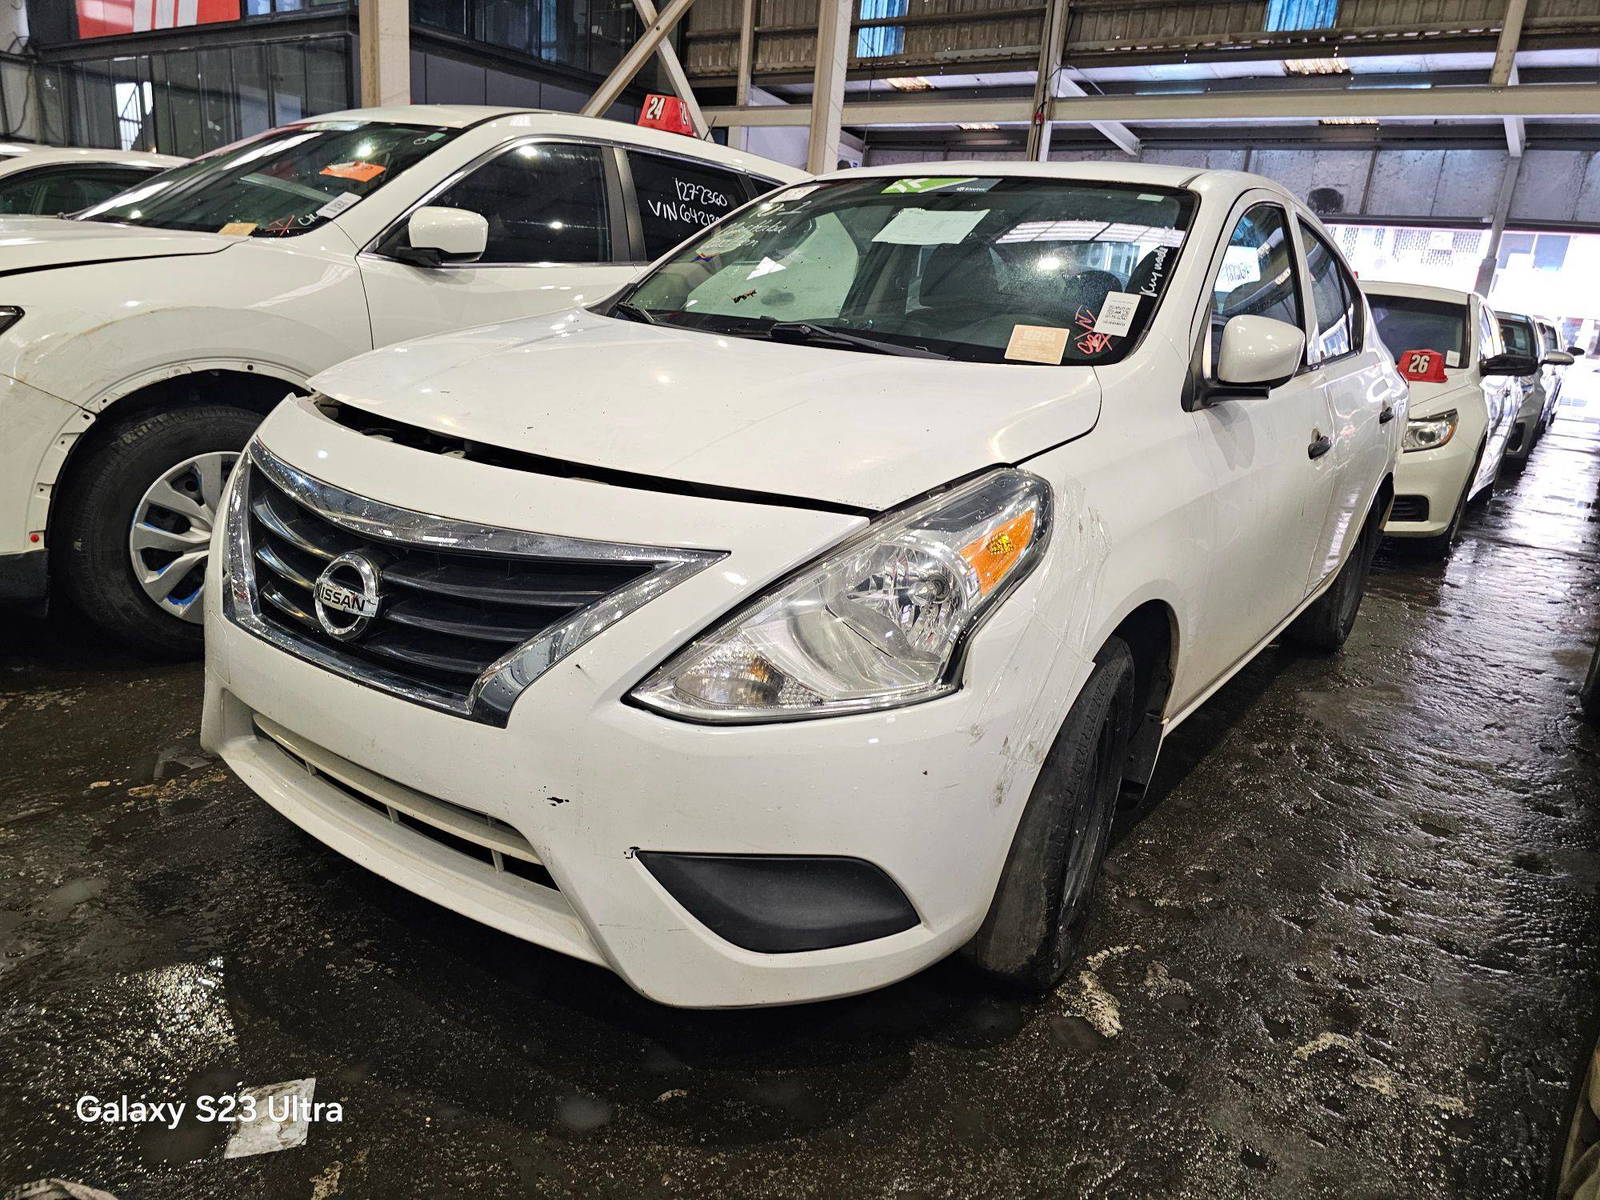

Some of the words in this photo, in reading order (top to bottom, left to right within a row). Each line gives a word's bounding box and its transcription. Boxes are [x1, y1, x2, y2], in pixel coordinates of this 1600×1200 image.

[646, 97, 665, 120] 24
[1408, 354, 1429, 373] 26
[314, 581, 366, 612] NISSAN
